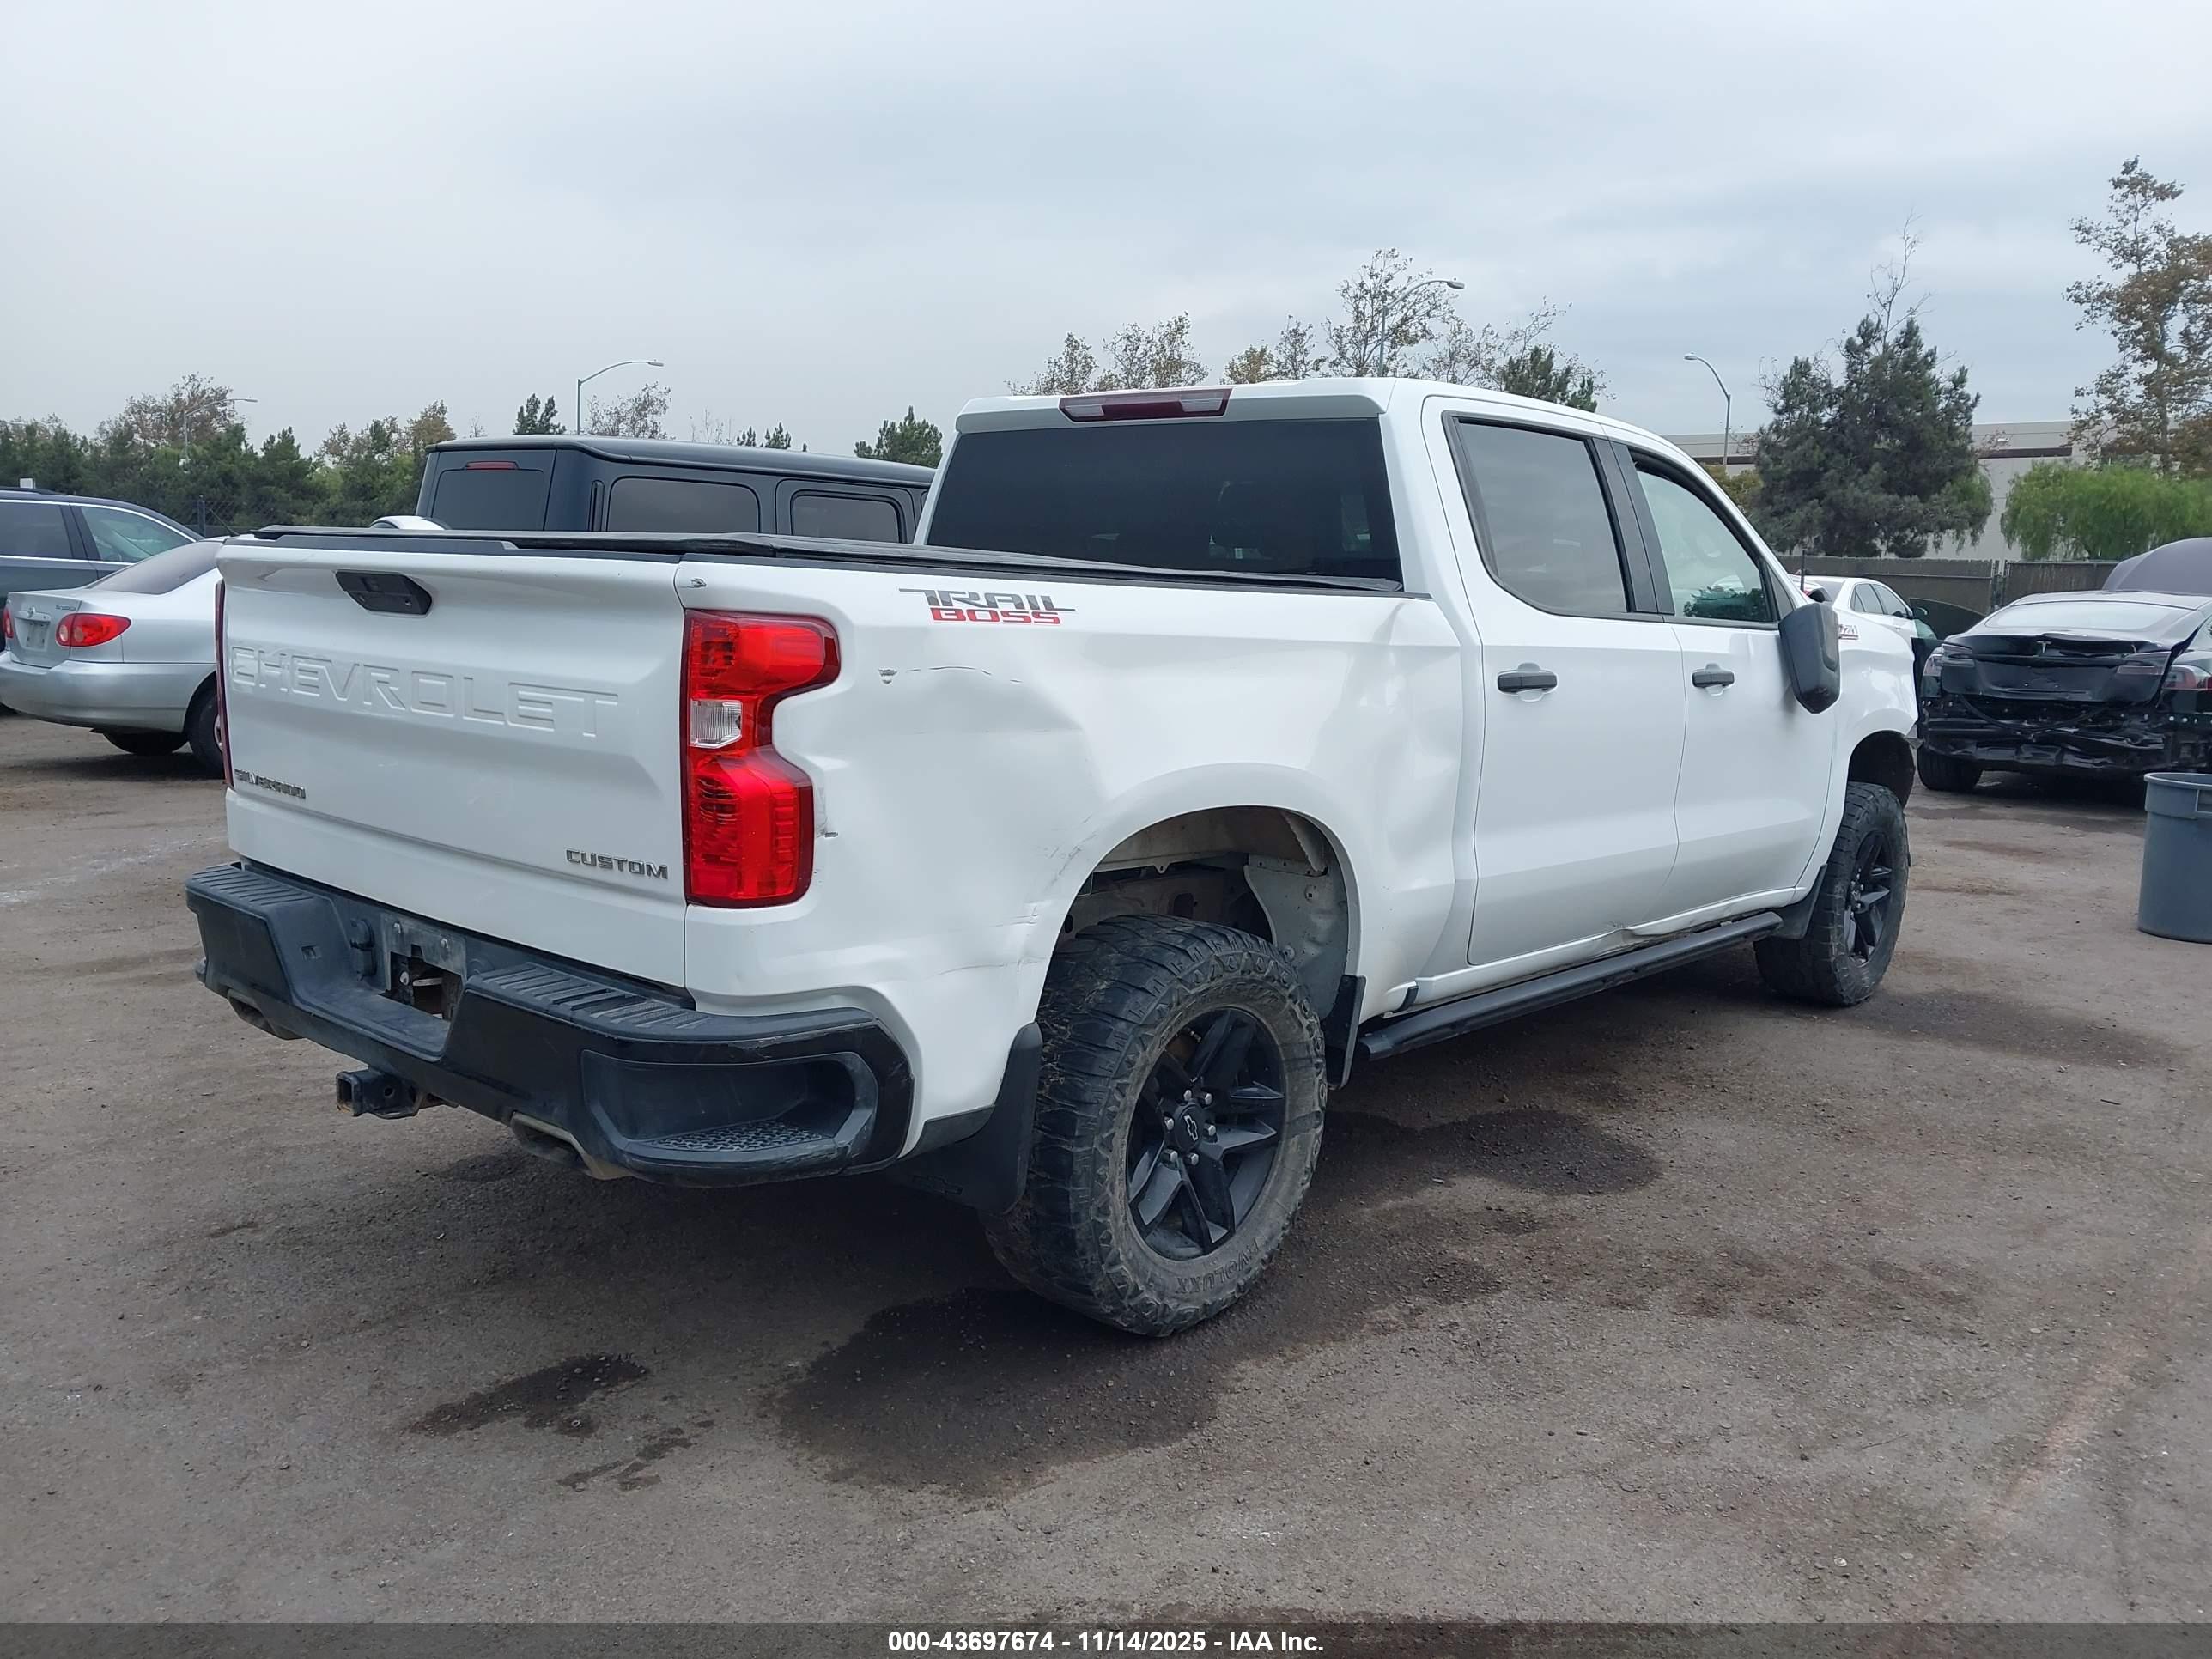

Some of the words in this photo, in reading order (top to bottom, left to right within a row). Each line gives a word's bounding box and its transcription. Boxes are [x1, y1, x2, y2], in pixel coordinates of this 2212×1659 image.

[899, 587, 1076, 611] TRAIL
[930, 607, 1061, 625] BOSS
[230, 645, 619, 738] CHEVROLET
[565, 848, 668, 880] CUSTOM
